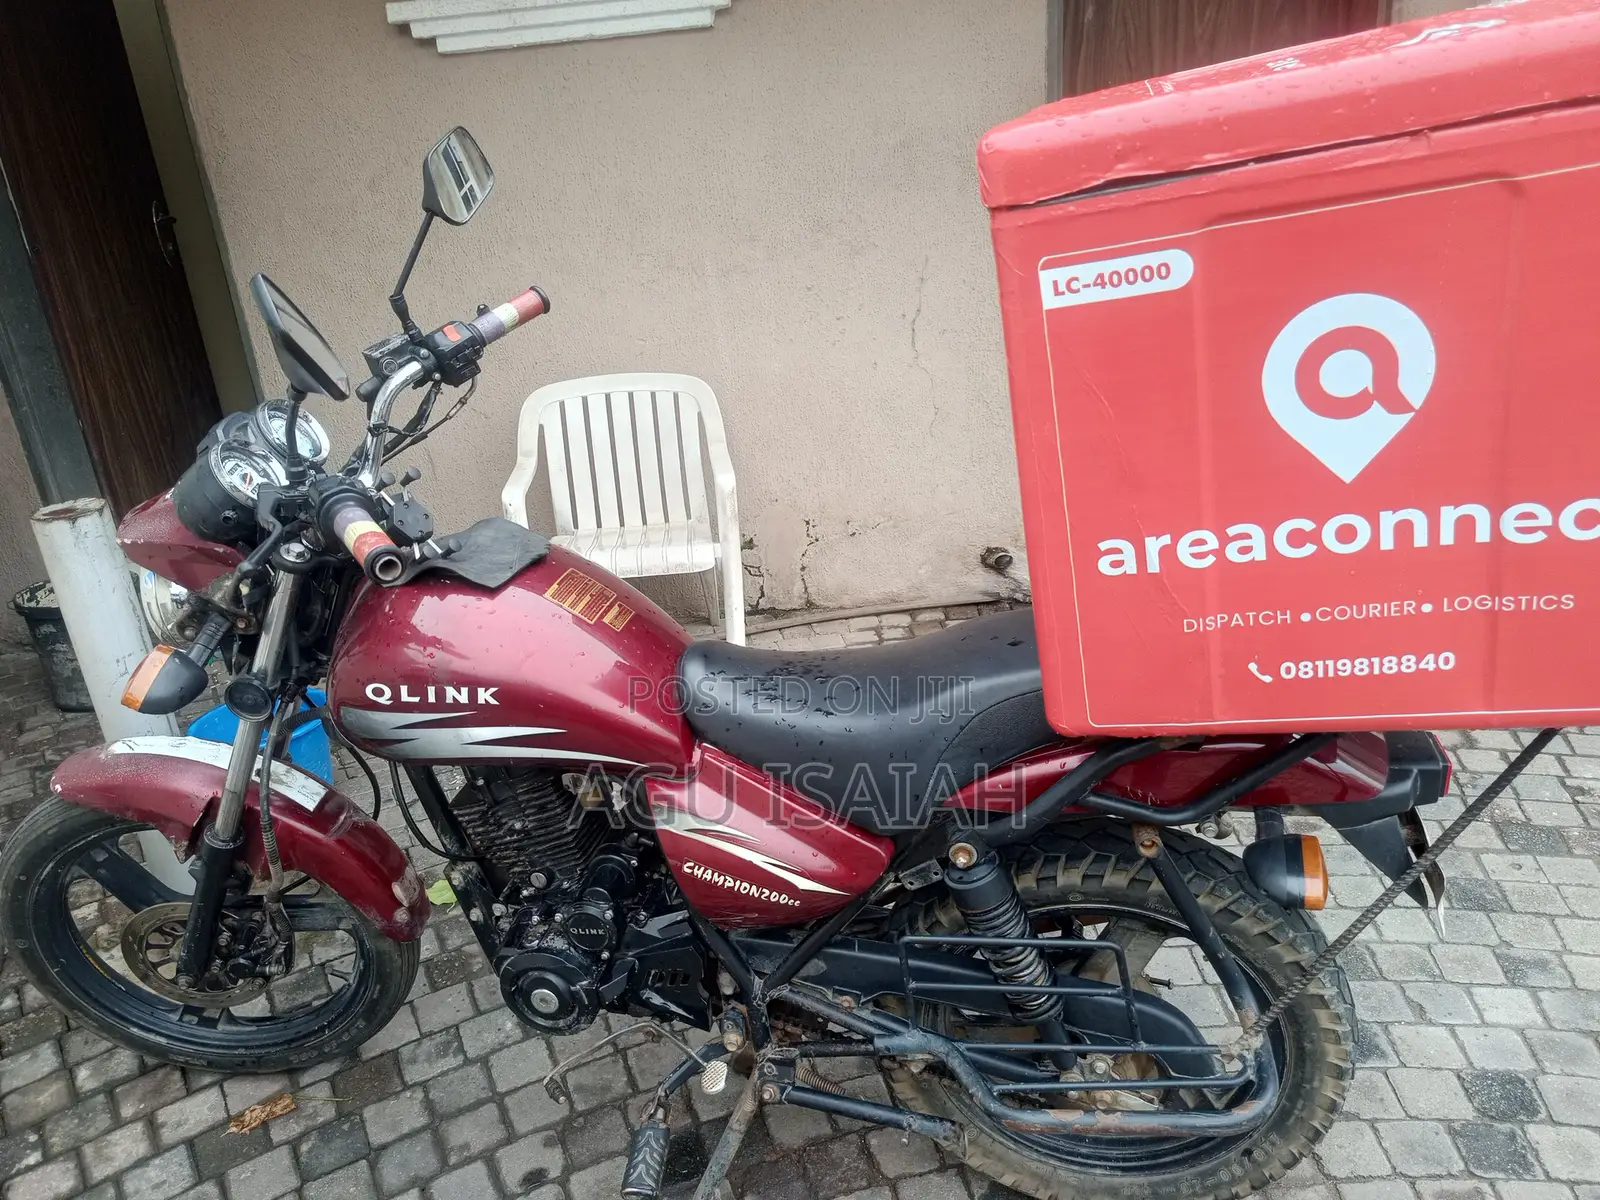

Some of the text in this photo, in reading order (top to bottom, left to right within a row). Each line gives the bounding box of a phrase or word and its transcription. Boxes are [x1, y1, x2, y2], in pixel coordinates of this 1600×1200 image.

[1052, 262, 1171, 296] LC-40000
[1183, 595, 1575, 633] DISPATCH COURIER LOGISTICS
[1279, 652, 1456, 680] 08119818840
[365, 683, 500, 705] QLINK
[570, 927, 605, 935] QLINK
